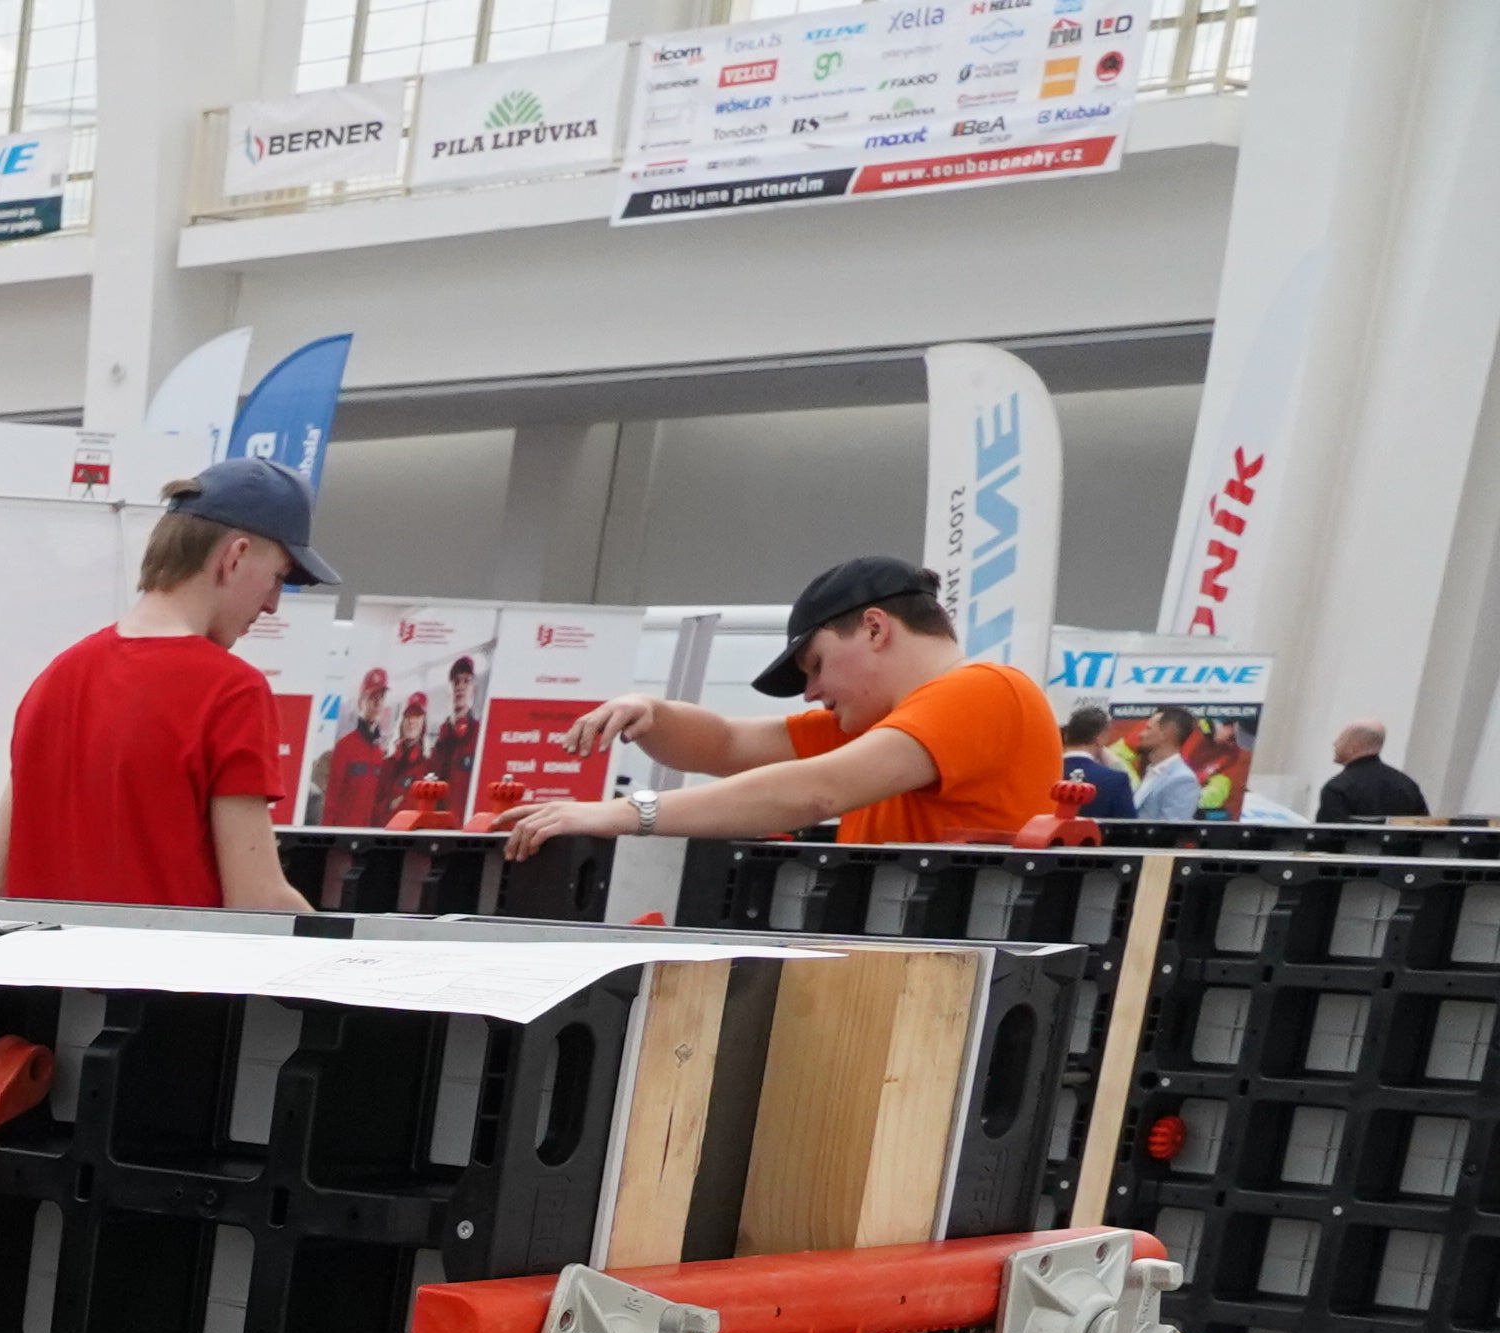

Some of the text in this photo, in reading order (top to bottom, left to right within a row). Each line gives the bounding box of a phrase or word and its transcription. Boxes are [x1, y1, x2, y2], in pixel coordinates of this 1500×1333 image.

[890, 73, 938, 89] FAKRO
[268, 120, 384, 156] BERNER
[713, 123, 768, 141] Tondach
[864, 126, 928, 149] maxit
[432, 134, 485, 159] PILA
[880, 147, 1084, 184] www.soubosonohy.cz
[650, 177, 825, 211] Děkujeme partnerům
[1123, 665, 1263, 685] XTLINE
